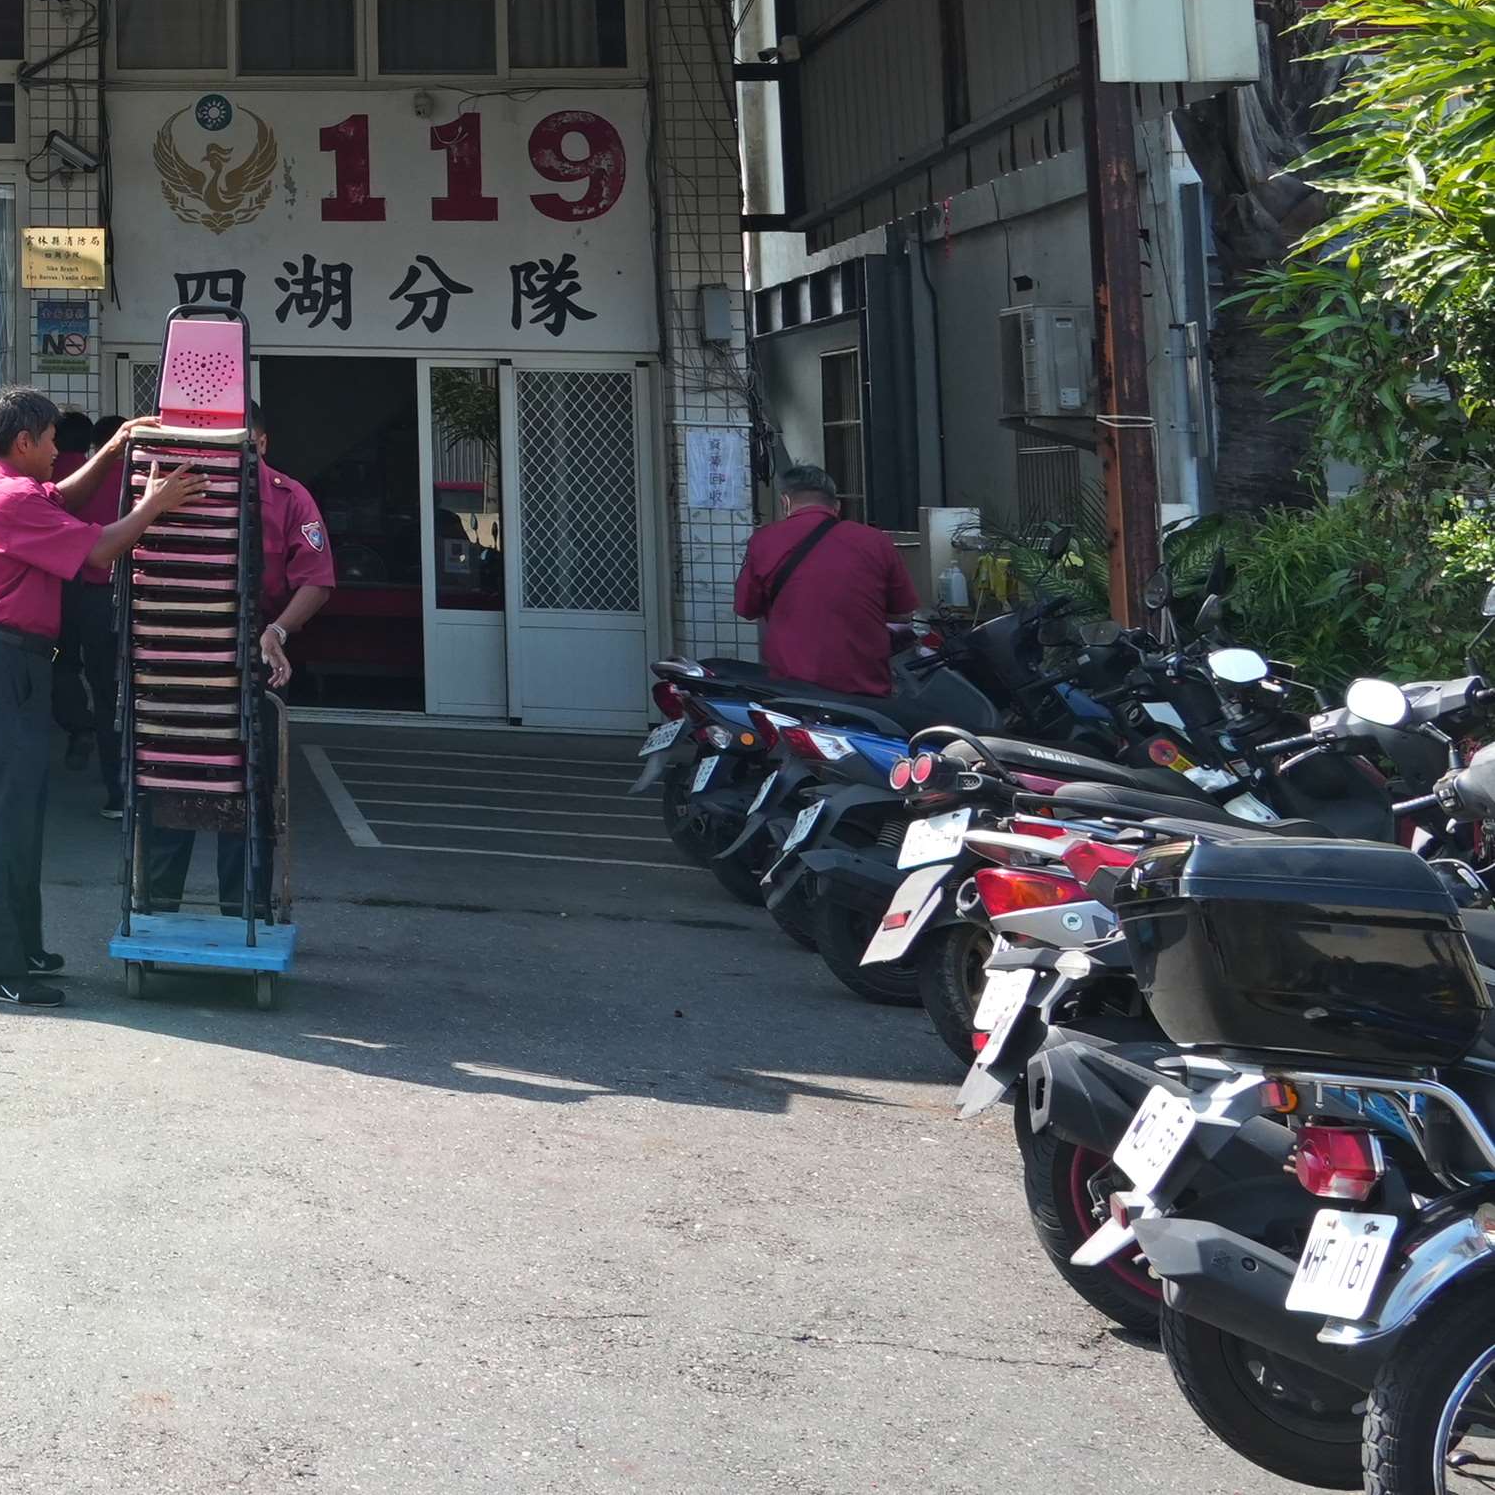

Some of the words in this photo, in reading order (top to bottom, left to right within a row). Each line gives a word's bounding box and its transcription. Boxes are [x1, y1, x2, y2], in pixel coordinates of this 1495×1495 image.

[318, 109, 627, 223] 119
[173, 252, 598, 337] 四湖分隊
